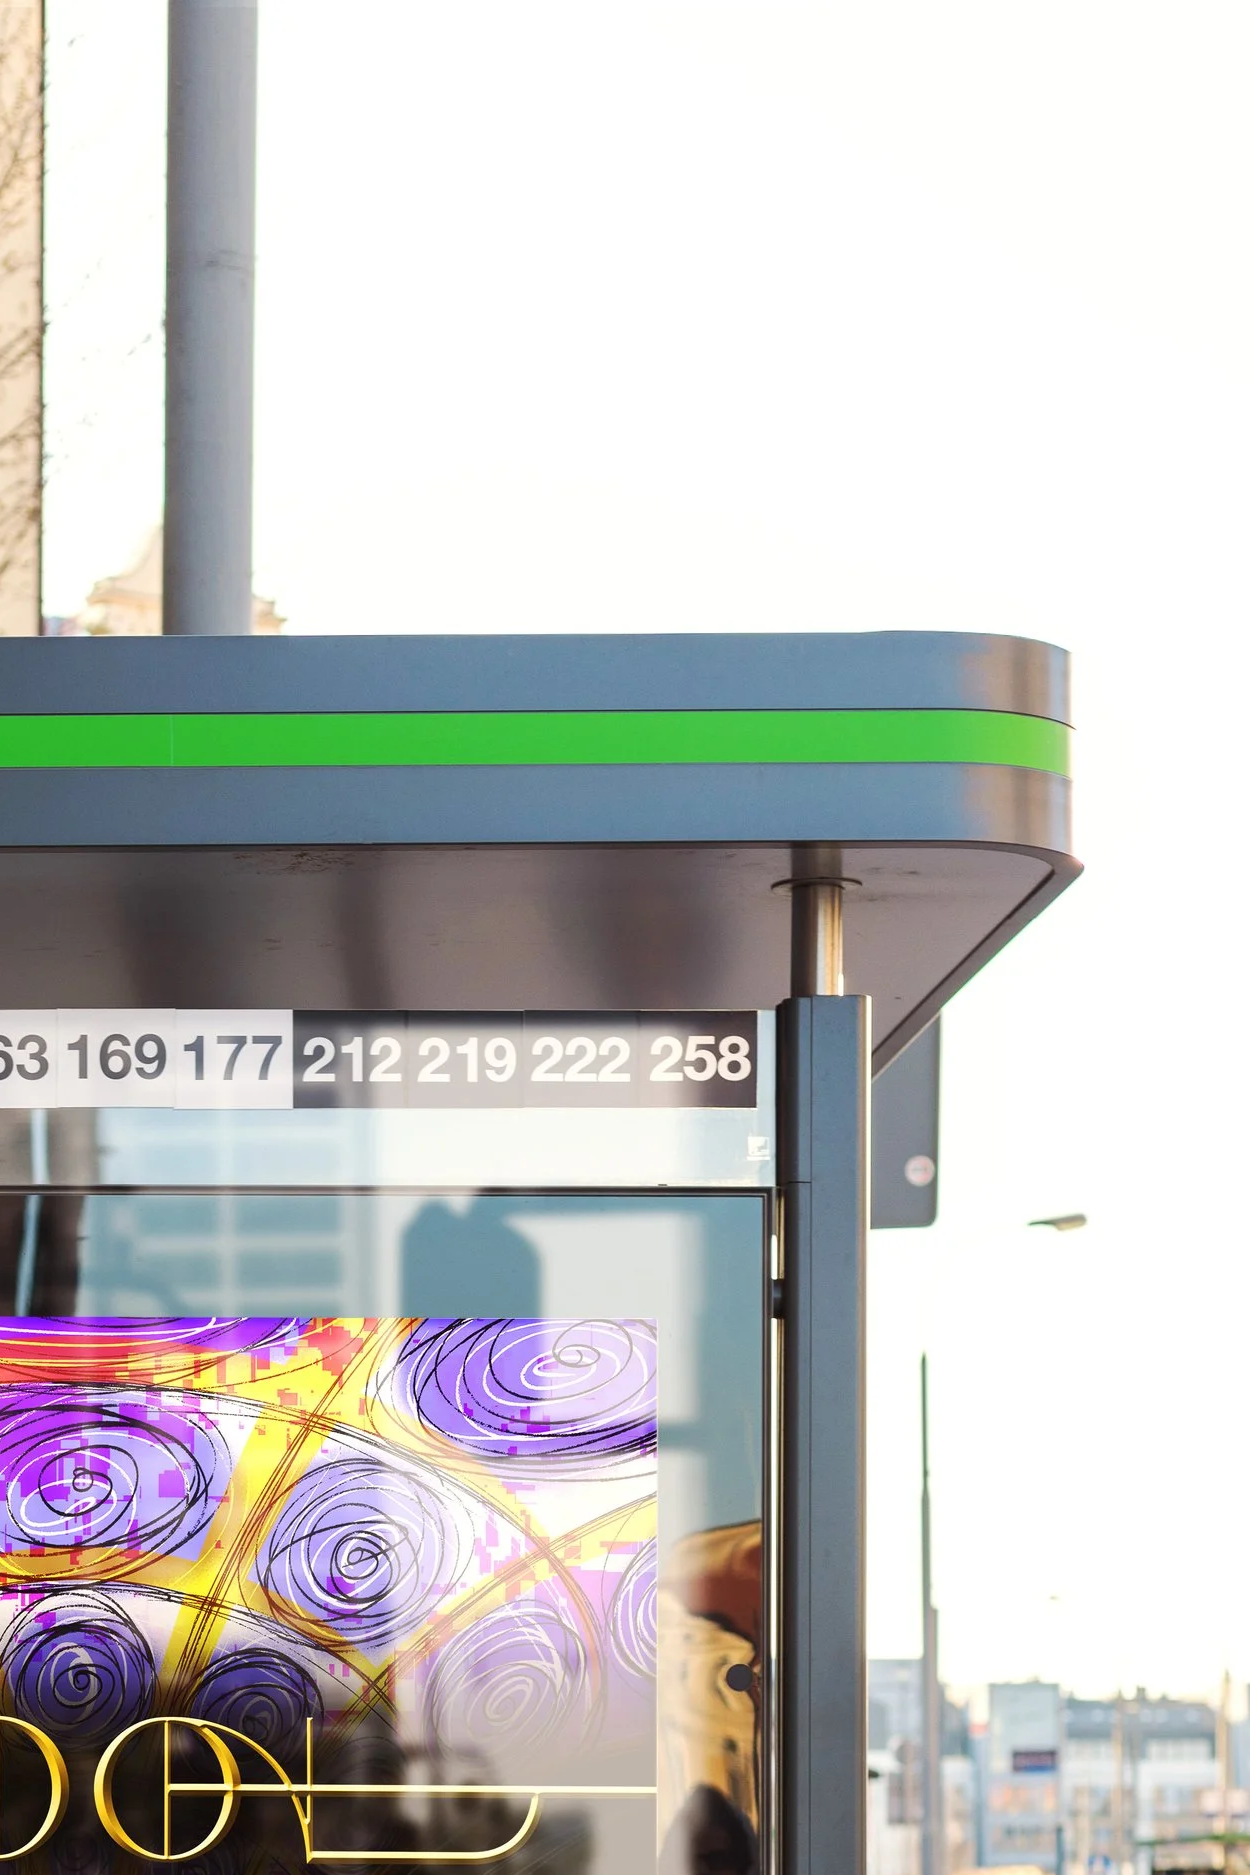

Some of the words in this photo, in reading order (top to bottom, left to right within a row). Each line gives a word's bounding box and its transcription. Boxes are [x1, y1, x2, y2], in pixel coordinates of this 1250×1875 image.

[66, 1034, 168, 1080] 169
[182, 1036, 282, 1081] 177
[302, 1036, 402, 1083] 212
[417, 1037, 517, 1083] 219
[531, 1037, 631, 1083] 222
[651, 1035, 752, 1083] 258
